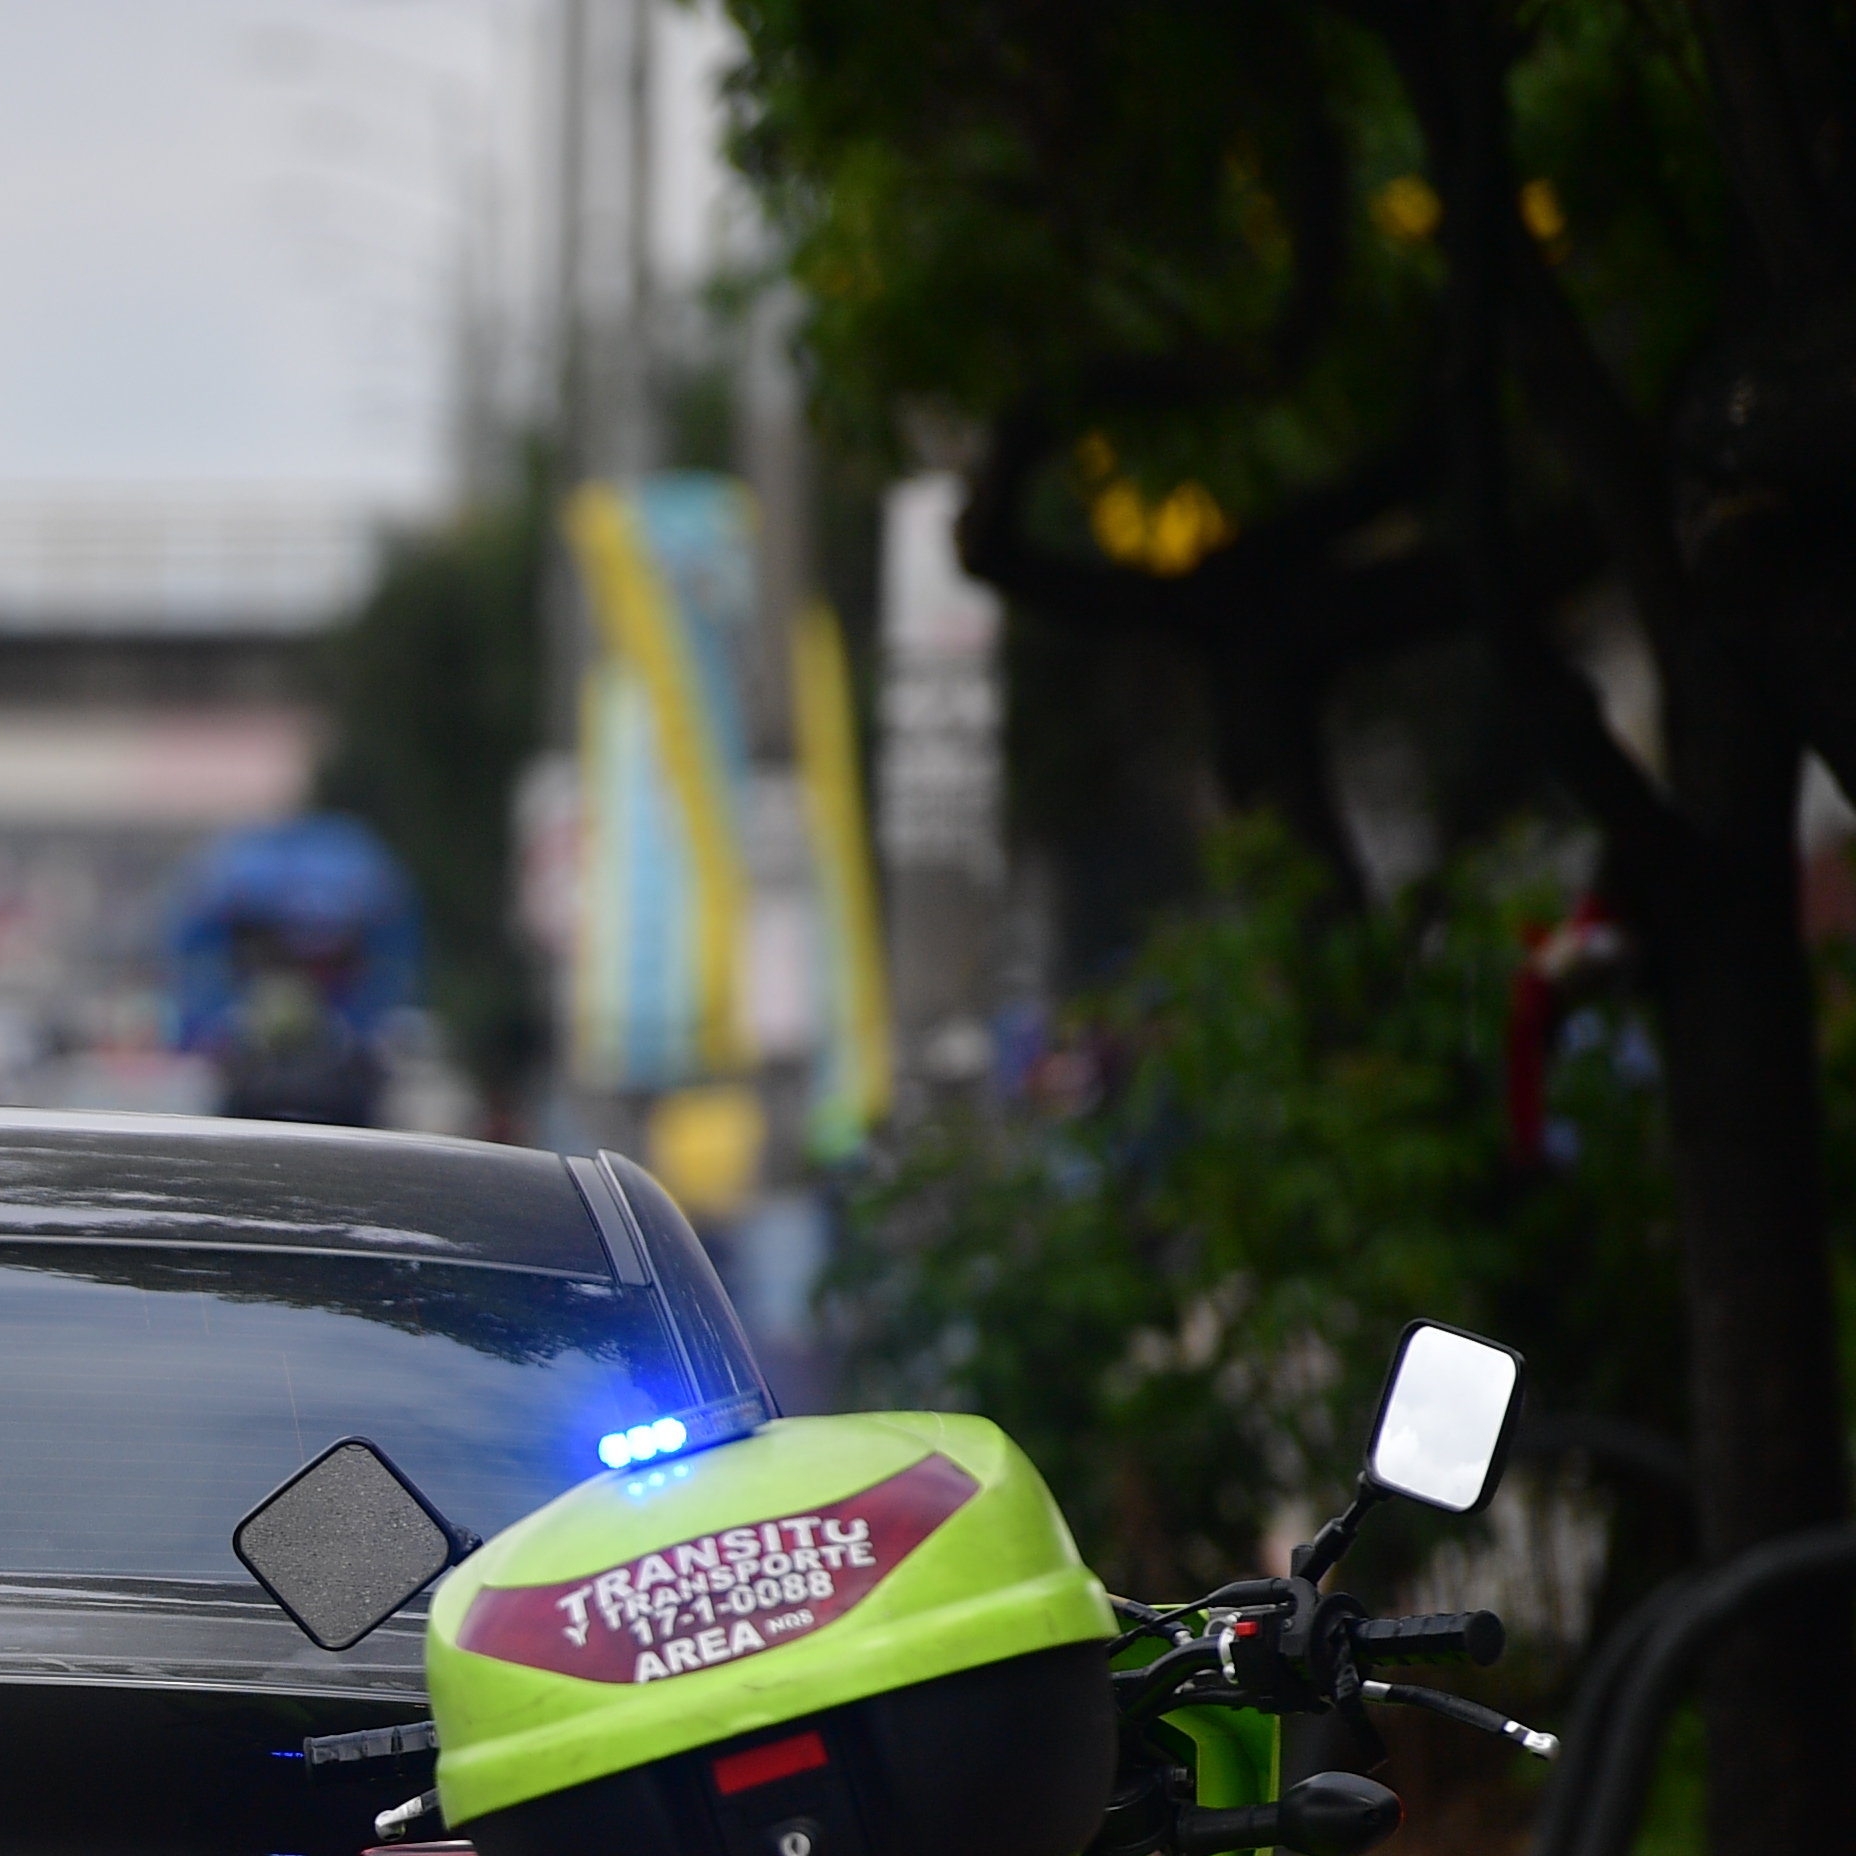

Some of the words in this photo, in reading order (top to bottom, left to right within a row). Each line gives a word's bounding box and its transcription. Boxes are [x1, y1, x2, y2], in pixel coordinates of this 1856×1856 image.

[563, 1621, 590, 1647] Y
[602, 1541, 876, 1631] TRANSPORTE
[634, 1620, 766, 1684] AREA
